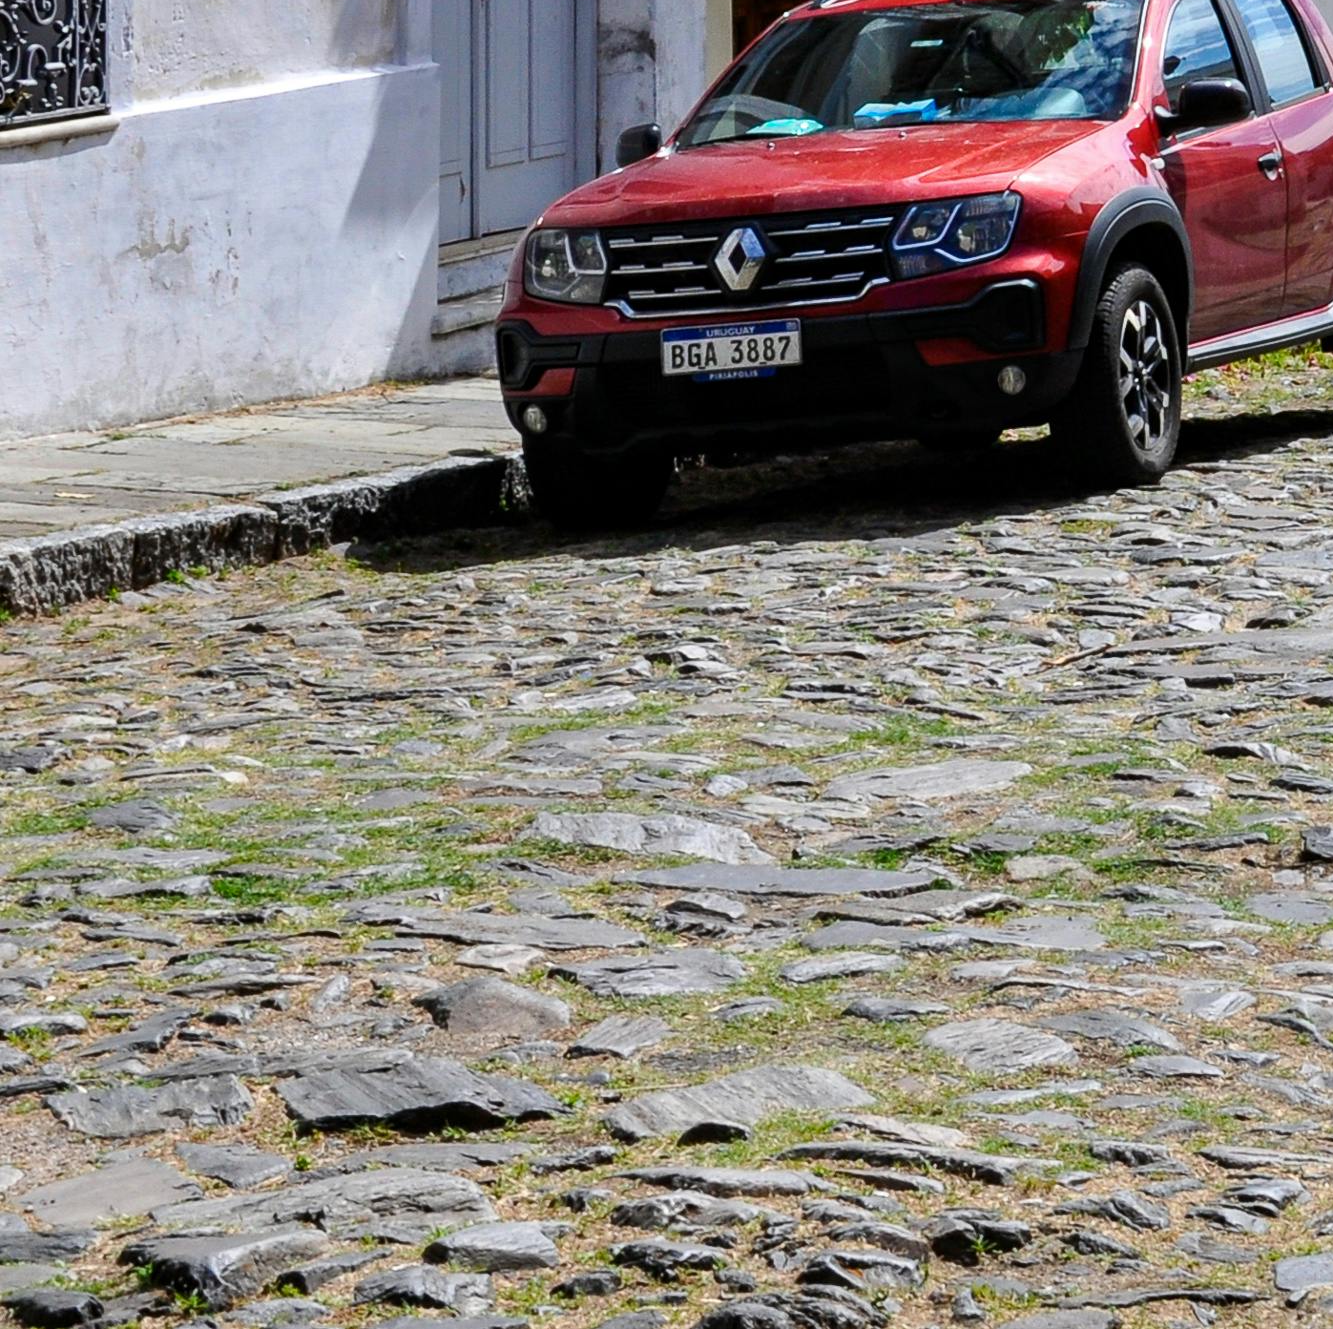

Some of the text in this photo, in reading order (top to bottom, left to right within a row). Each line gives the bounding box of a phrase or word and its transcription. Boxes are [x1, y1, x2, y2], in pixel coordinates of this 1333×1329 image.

[706, 326, 755, 338] URUGUAY
[671, 336, 791, 369] BGA 3887
